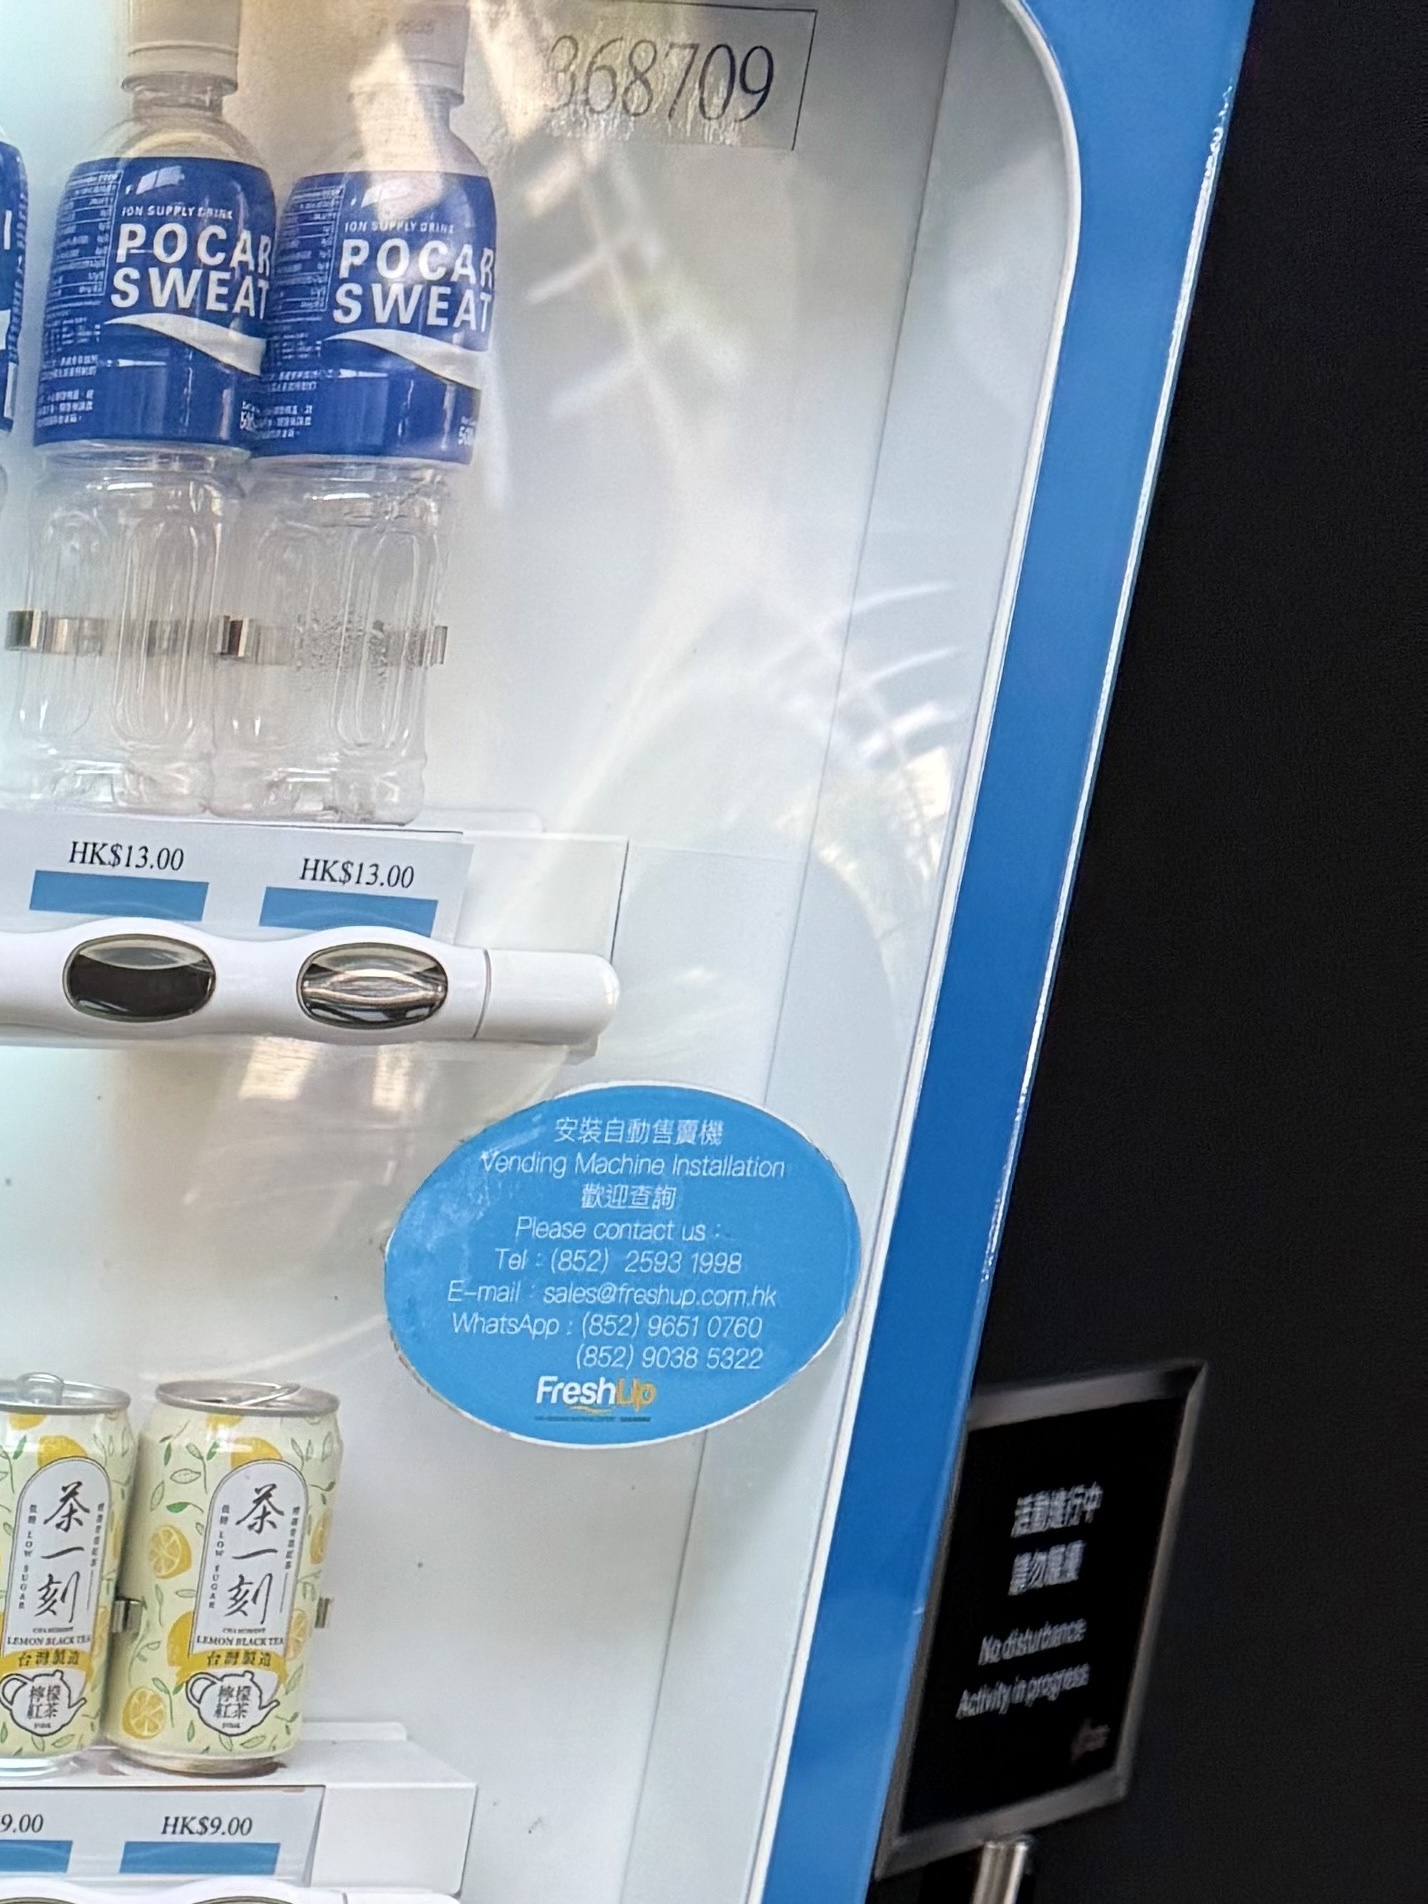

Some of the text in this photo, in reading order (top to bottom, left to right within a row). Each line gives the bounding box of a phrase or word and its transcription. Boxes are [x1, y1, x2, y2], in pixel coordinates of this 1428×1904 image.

[69, 841, 184, 871] HK$13.00
[300, 858, 414, 888] HK$13.00
[555, 1117, 723, 1145] 安裝自動售賣機
[482, 1152, 784, 1180] Vending Machine Installation
[581, 1183, 677, 1210] 歡迎查詢
[516, 1216, 706, 1241] Please contact us
[495, 1248, 742, 1274] Tel (852) 2593 1998
[447, 1277, 776, 1309] E-mail sales@freshup.com.hk
[453, 1312, 763, 1339] WhatsApp (852) 9651 0760
[576, 1344, 763, 1370] (852) 9038 5322
[537, 1376, 656, 1409] FreshUp
[1010, 1482, 1103, 1538] 活動進行中
[224, 1483, 285, 1625] 茶一刻
[978, 1618, 1087, 1666] No disturbance
[955, 1675, 1013, 1719] Activity
[1025, 1663, 1091, 1708] progress
[161, 1816, 253, 1835] HK$9.00
